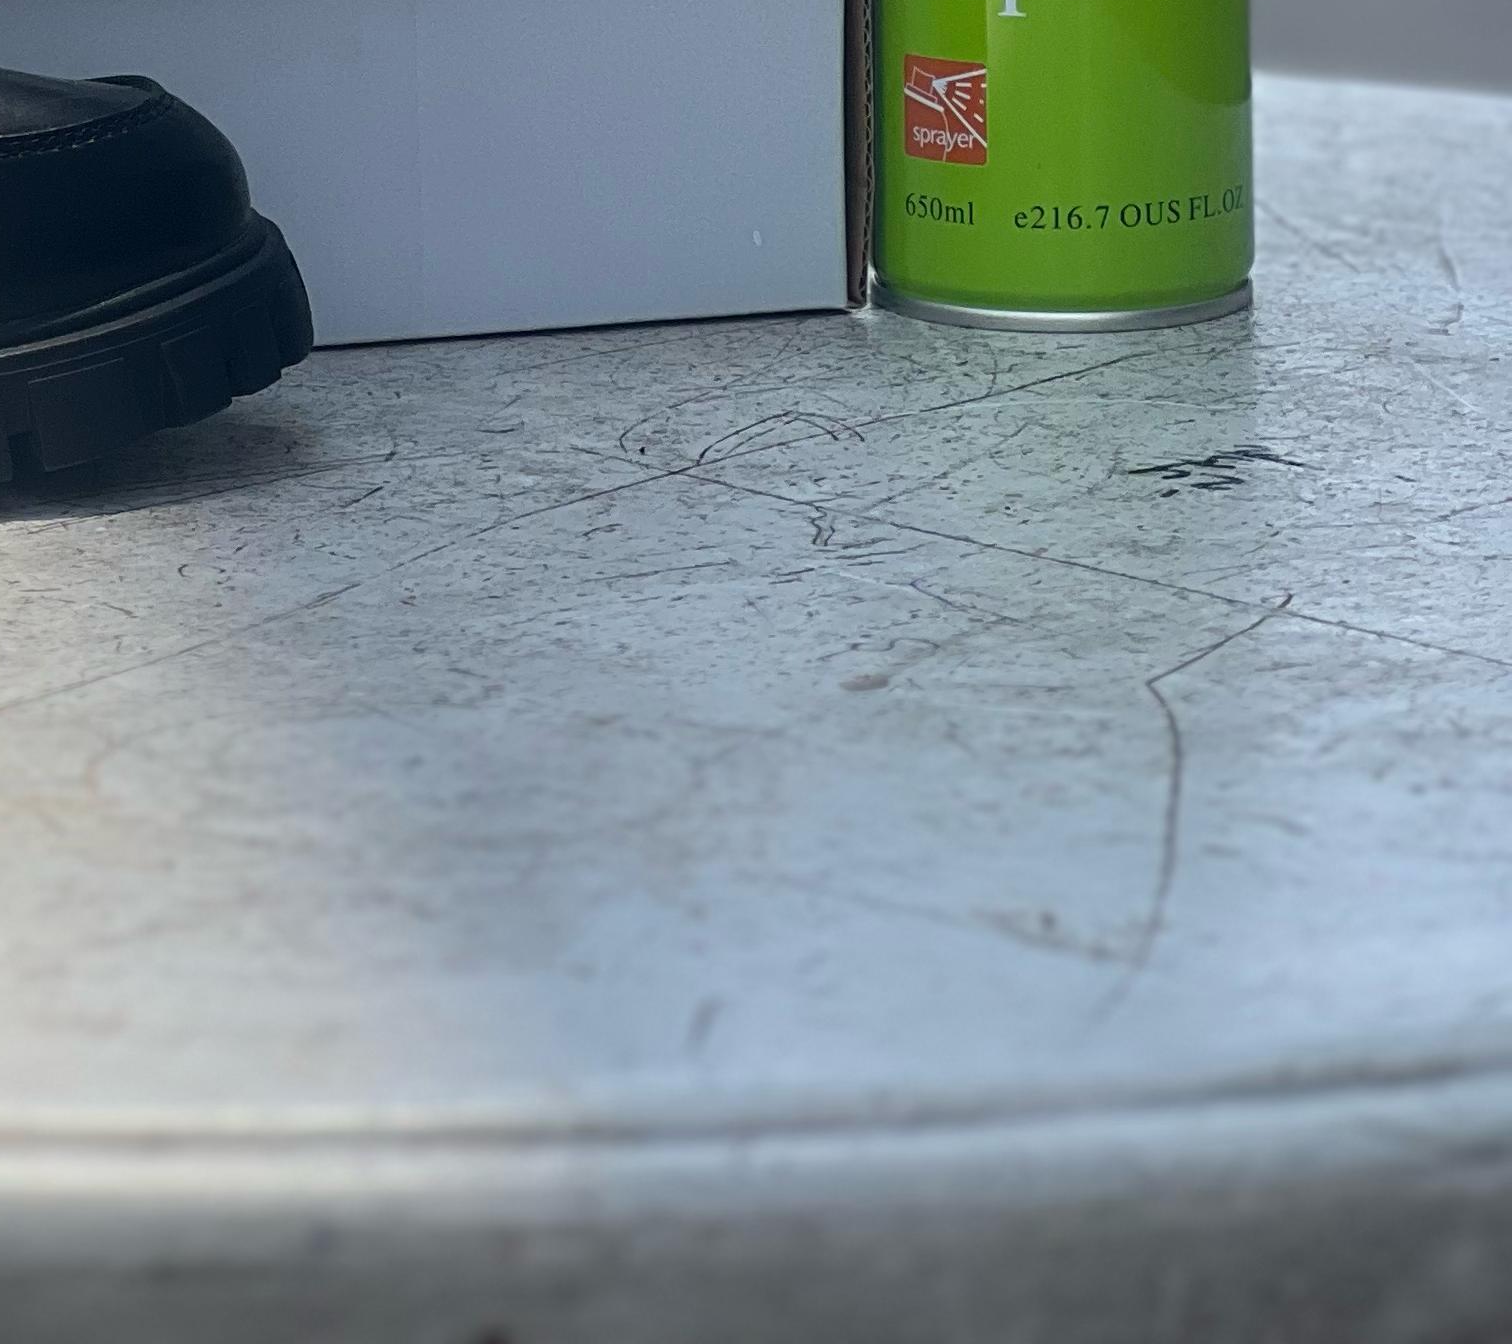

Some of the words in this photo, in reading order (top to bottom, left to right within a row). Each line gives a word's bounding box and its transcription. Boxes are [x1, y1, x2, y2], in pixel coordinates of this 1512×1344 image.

[912, 125, 975, 150] sprayer
[904, 192, 975, 226] 650ml
[1120, 199, 1181, 229] OUS
